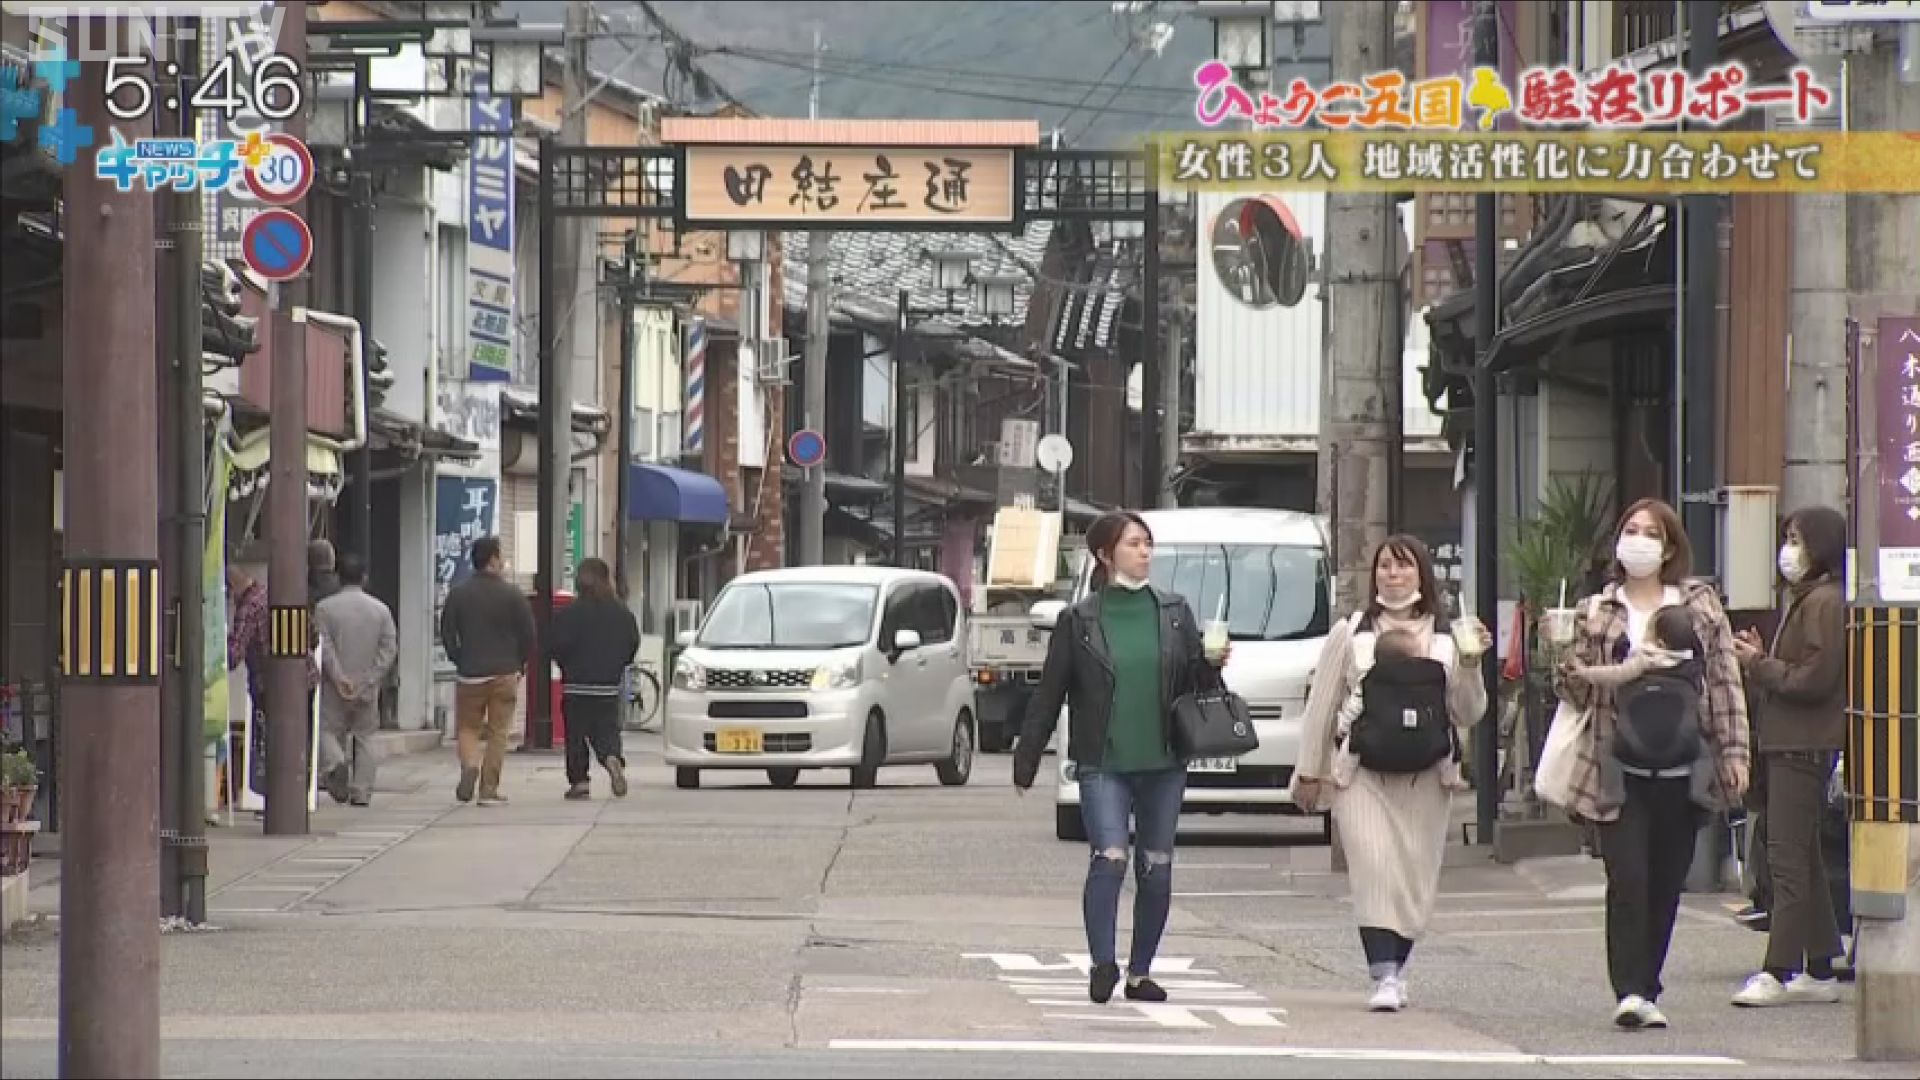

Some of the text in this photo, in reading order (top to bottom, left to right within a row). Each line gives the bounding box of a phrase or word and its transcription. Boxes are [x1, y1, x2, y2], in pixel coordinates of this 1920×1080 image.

[260, 154, 299, 185] 30
[723, 153, 973, 215] 田結庄通
